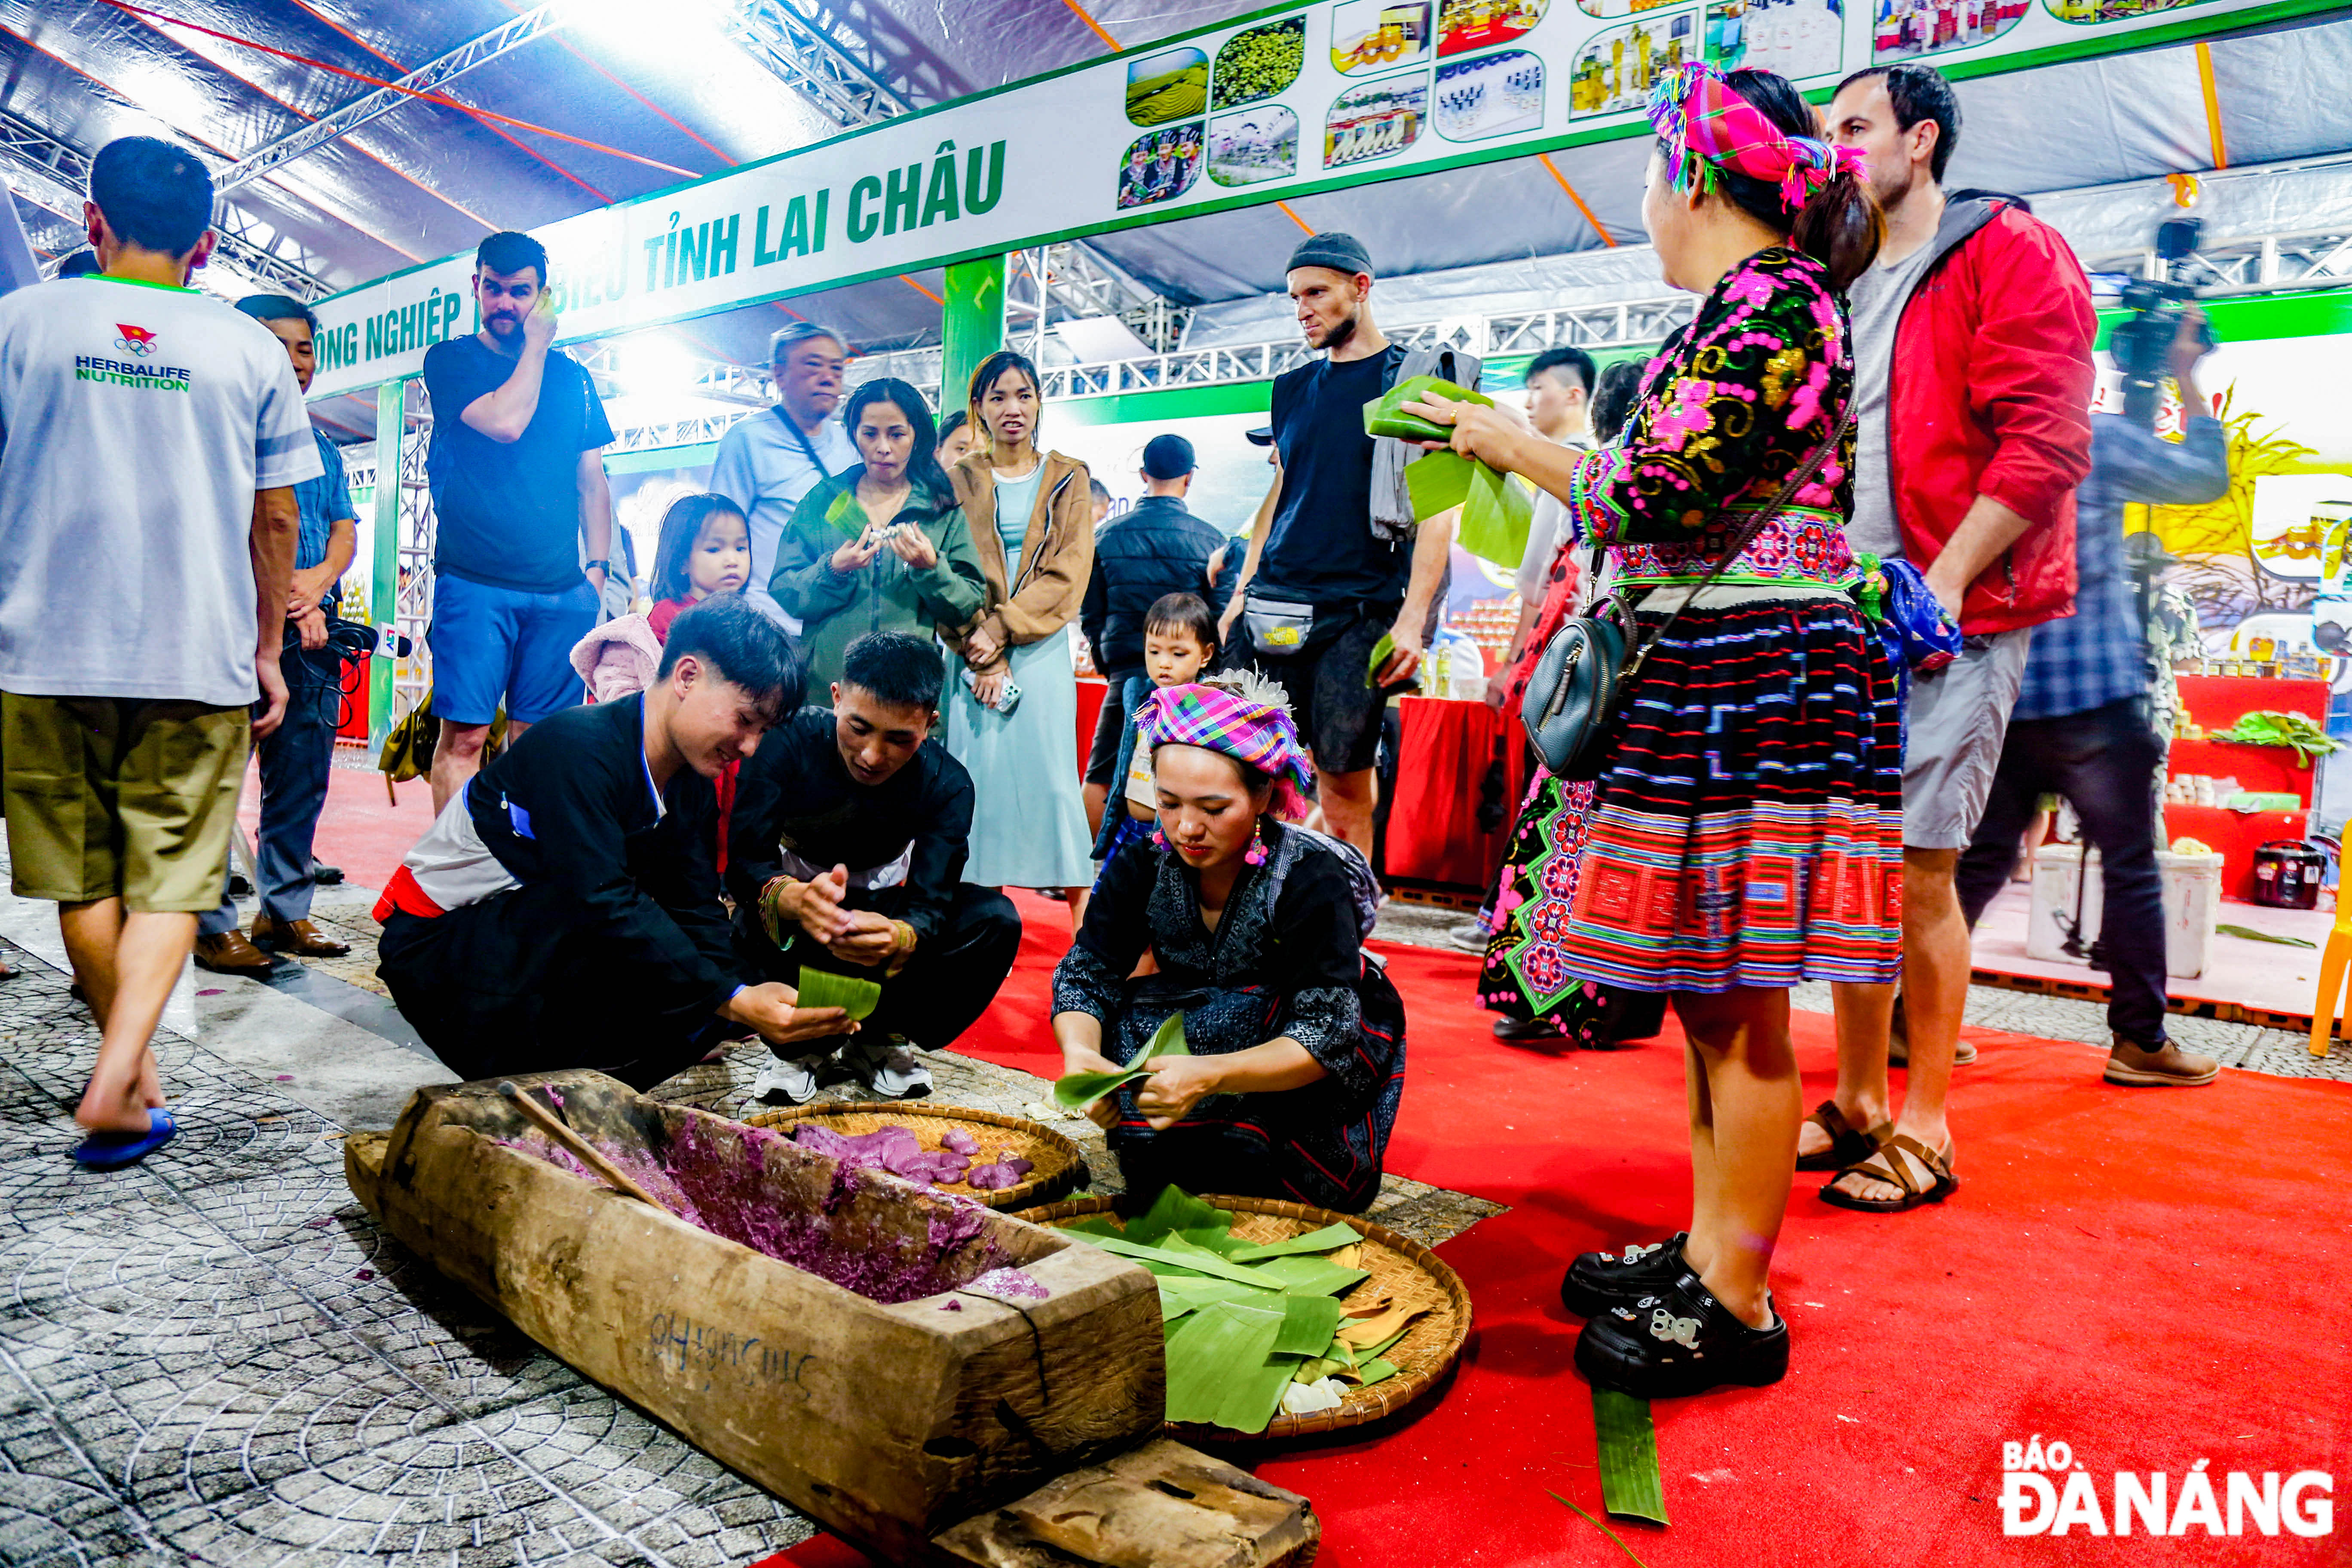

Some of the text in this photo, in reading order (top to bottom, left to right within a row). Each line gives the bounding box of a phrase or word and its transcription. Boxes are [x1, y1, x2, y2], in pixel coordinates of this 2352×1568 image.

[313, 323, 358, 375] ÔNG
[643, 211, 740, 292] TỈNH
[753, 188, 830, 267] LAI
[846, 139, 1006, 244] CHÂU
[76, 355, 190, 381] HERBALIFE
[76, 368, 189, 392] NUTRITION
